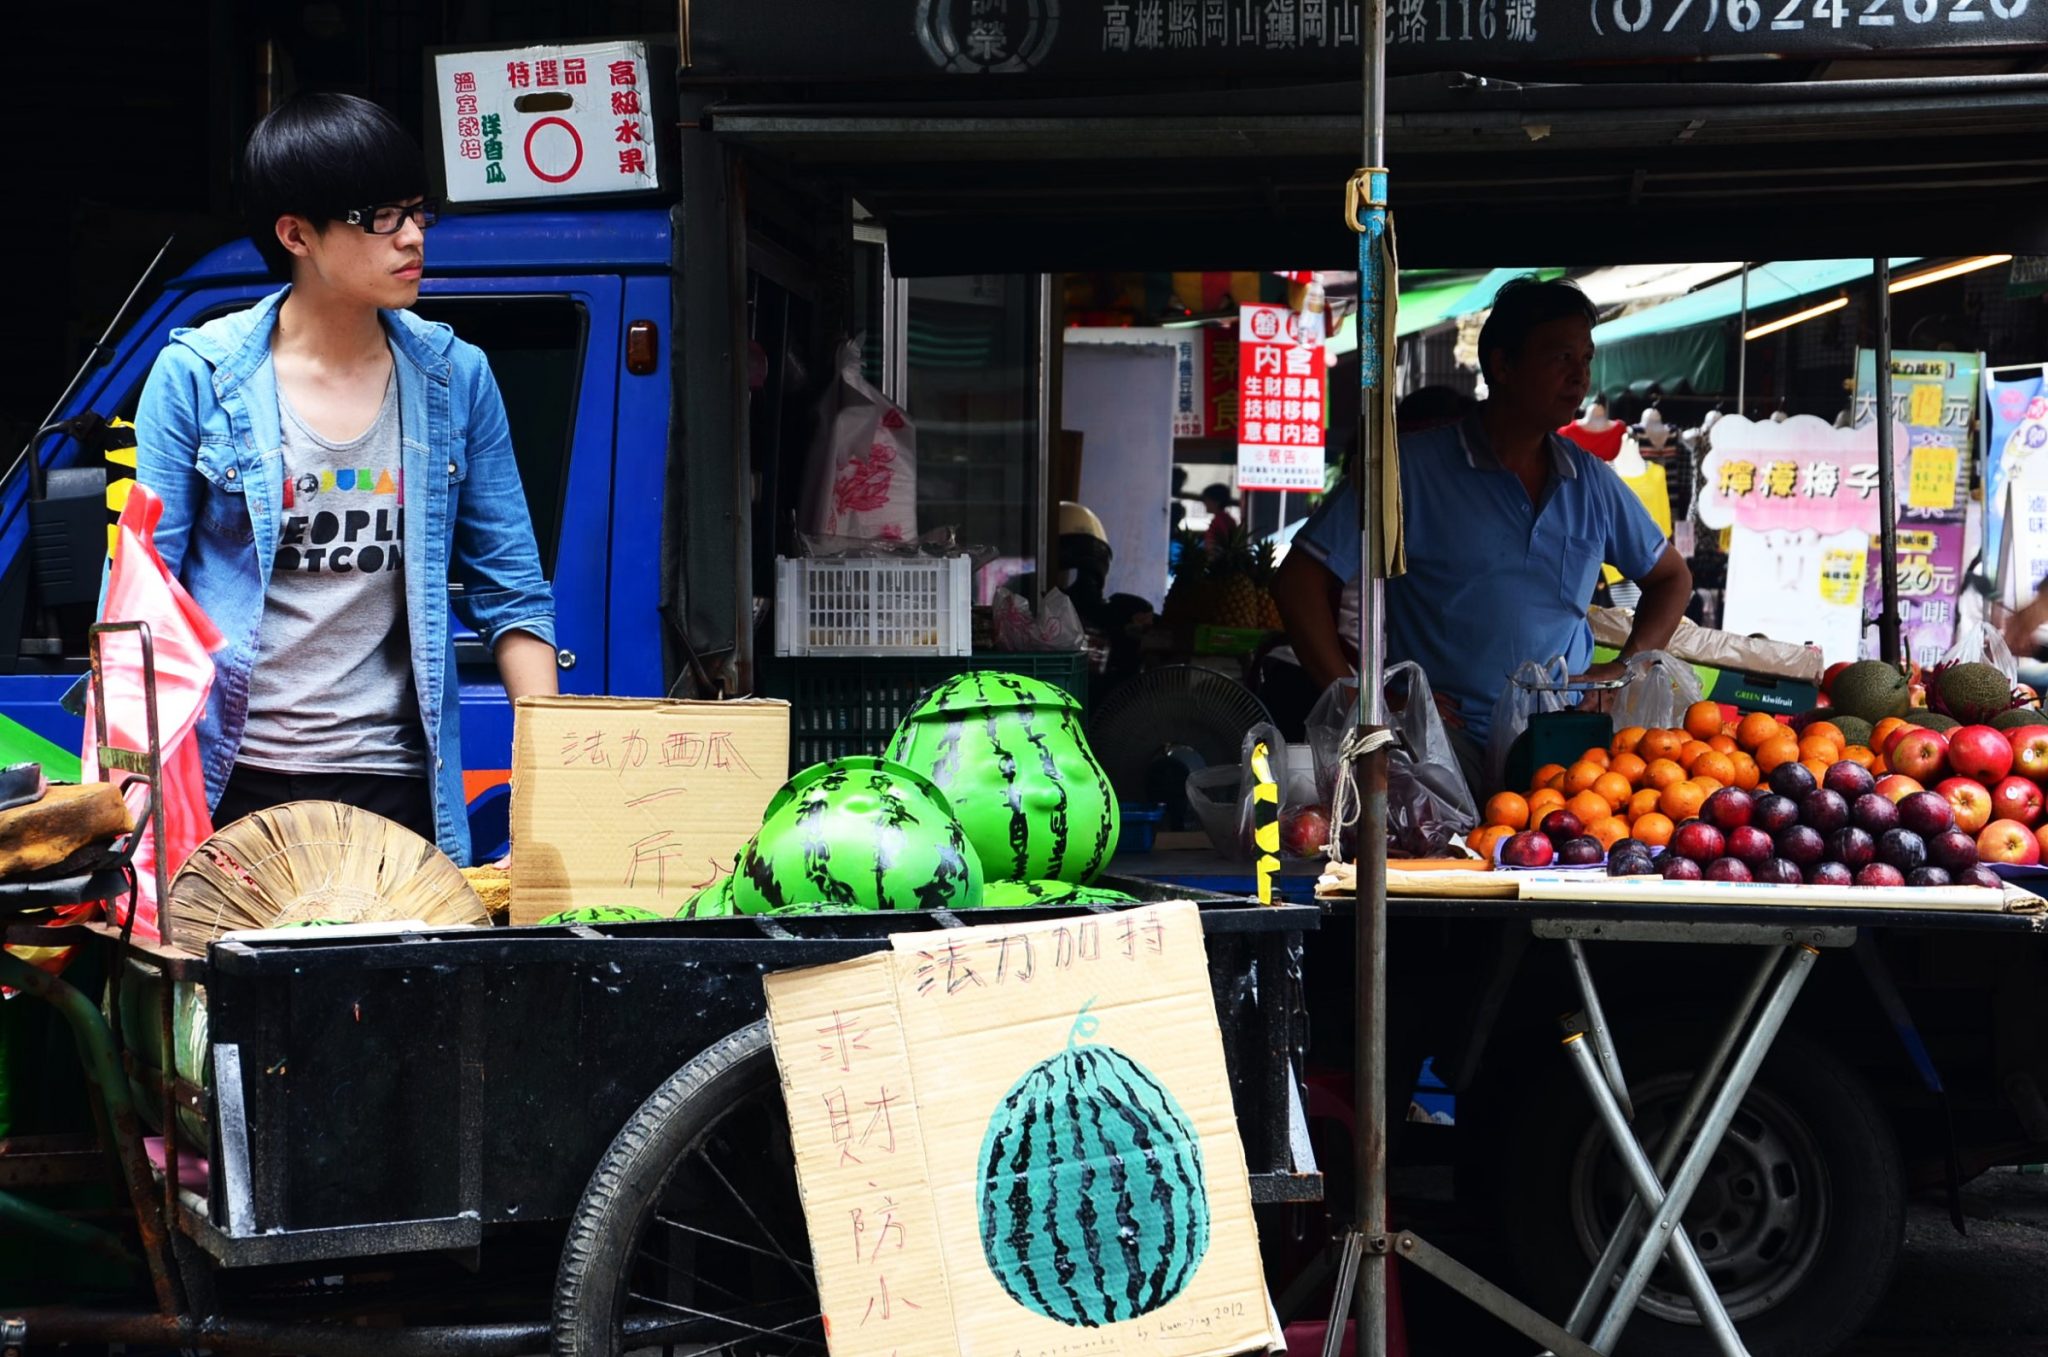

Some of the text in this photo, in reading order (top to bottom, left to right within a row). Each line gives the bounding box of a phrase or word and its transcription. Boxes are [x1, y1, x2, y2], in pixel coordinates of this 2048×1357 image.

[506, 57, 588, 89] 特選品
[607, 60, 646, 175] 高級水果
[481, 112, 507, 184] 洋香瓜
[280, 508, 404, 545] EOPL
[1735, 690, 1793, 707] GREEN Kiwifruit
[1213, 1301, 1246, 1321] 2012
